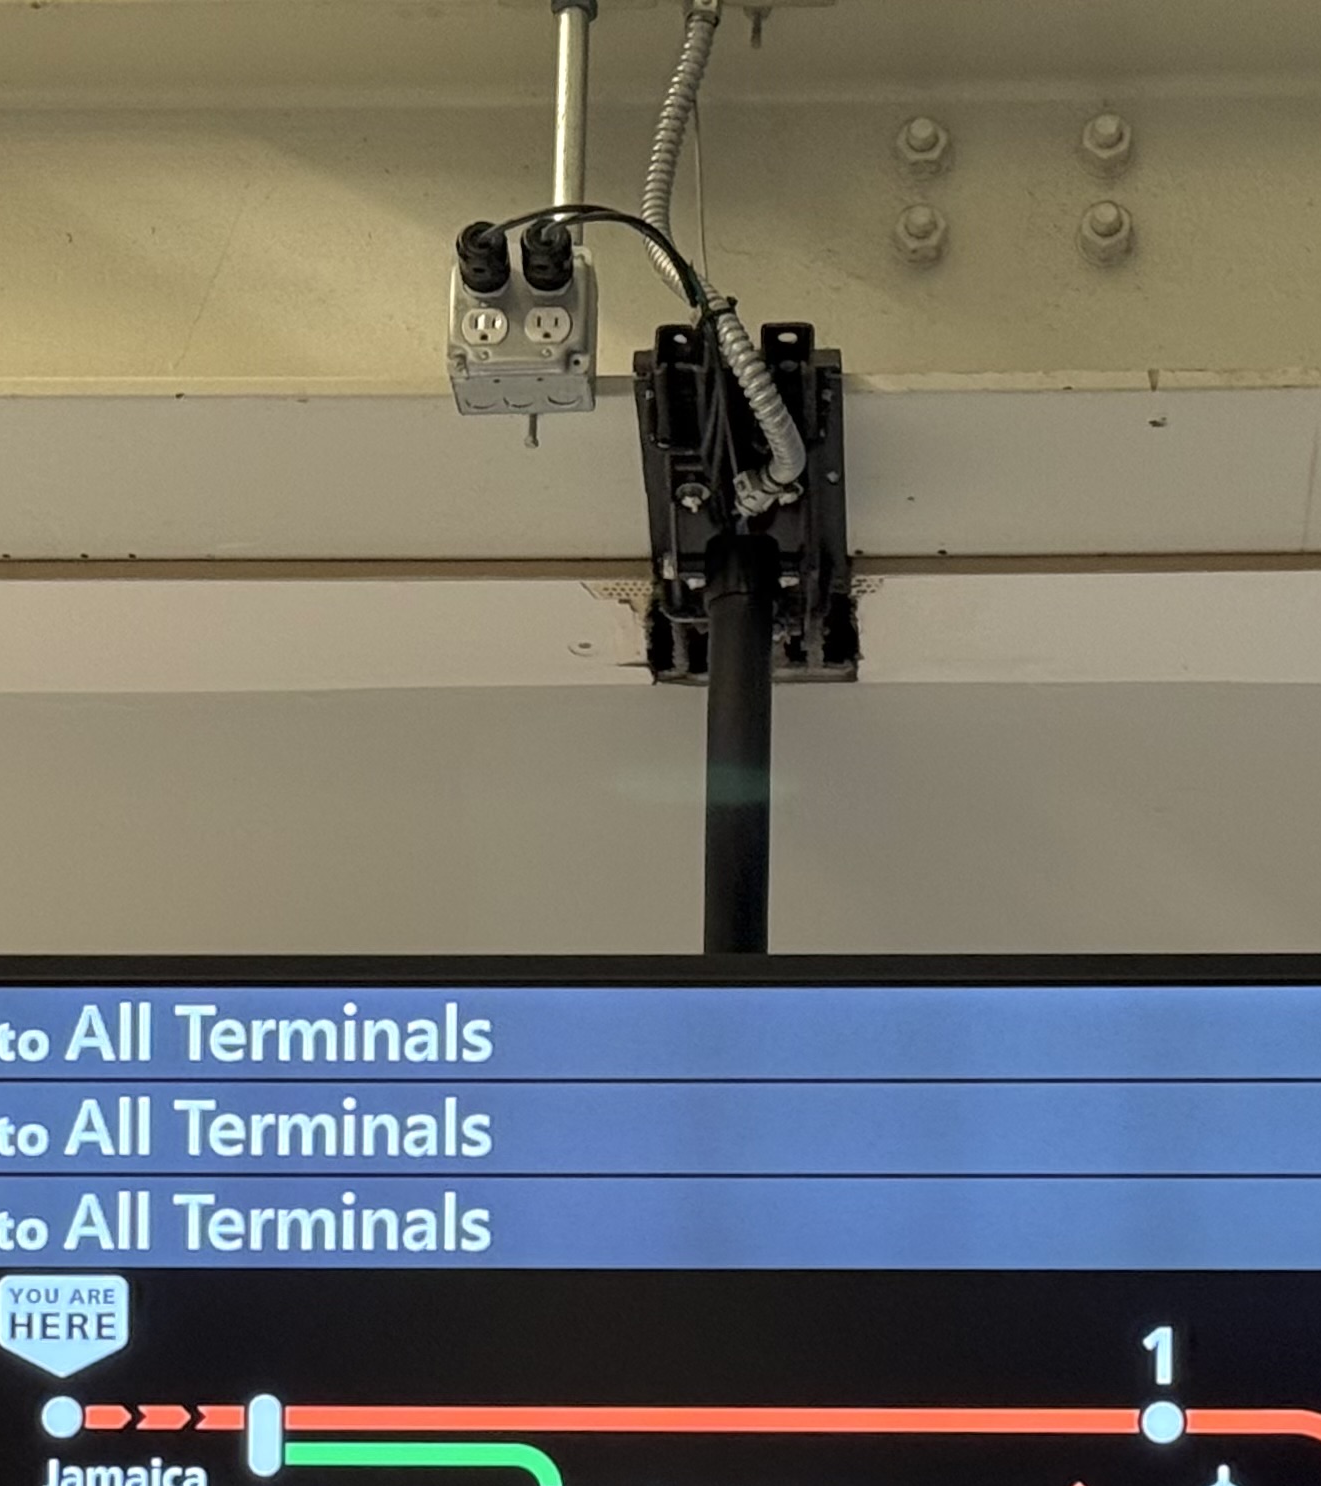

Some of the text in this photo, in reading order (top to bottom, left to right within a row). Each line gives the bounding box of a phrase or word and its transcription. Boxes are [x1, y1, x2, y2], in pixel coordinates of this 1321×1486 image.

[64, 1001, 151, 1061] All
[174, 1002, 493, 1062] Terminals
[63, 1096, 151, 1156] All
[173, 1096, 492, 1157] Terminals
[63, 1190, 150, 1250] All
[172, 1191, 491, 1252] Terminals
[8, 1287, 115, 1305] YOU ARE
[9, 1312, 116, 1341] HERE
[1142, 1326, 1173, 1385] 1
